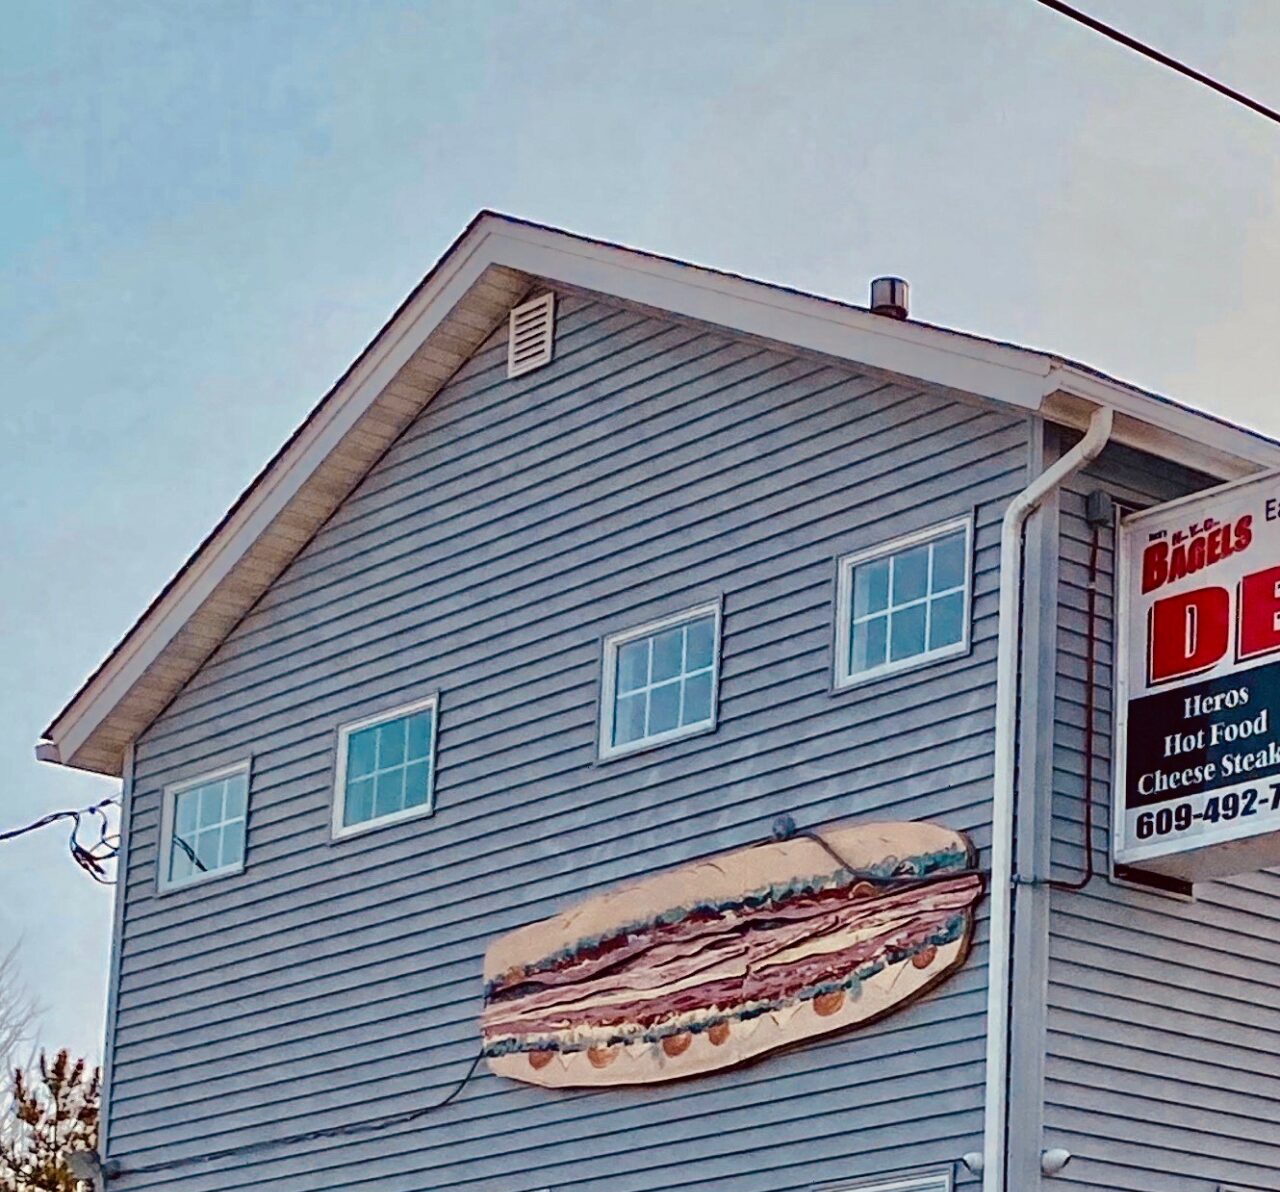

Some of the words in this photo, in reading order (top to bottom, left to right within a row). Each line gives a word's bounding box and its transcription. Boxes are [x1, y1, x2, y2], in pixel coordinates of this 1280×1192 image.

[1142, 515, 1253, 595] BAGELS
[1184, 687, 1249, 719] Heros
[1163, 725, 1206, 758] Hot
[1209, 709, 1268, 748] Food
[1137, 760, 1217, 796] Cheese
